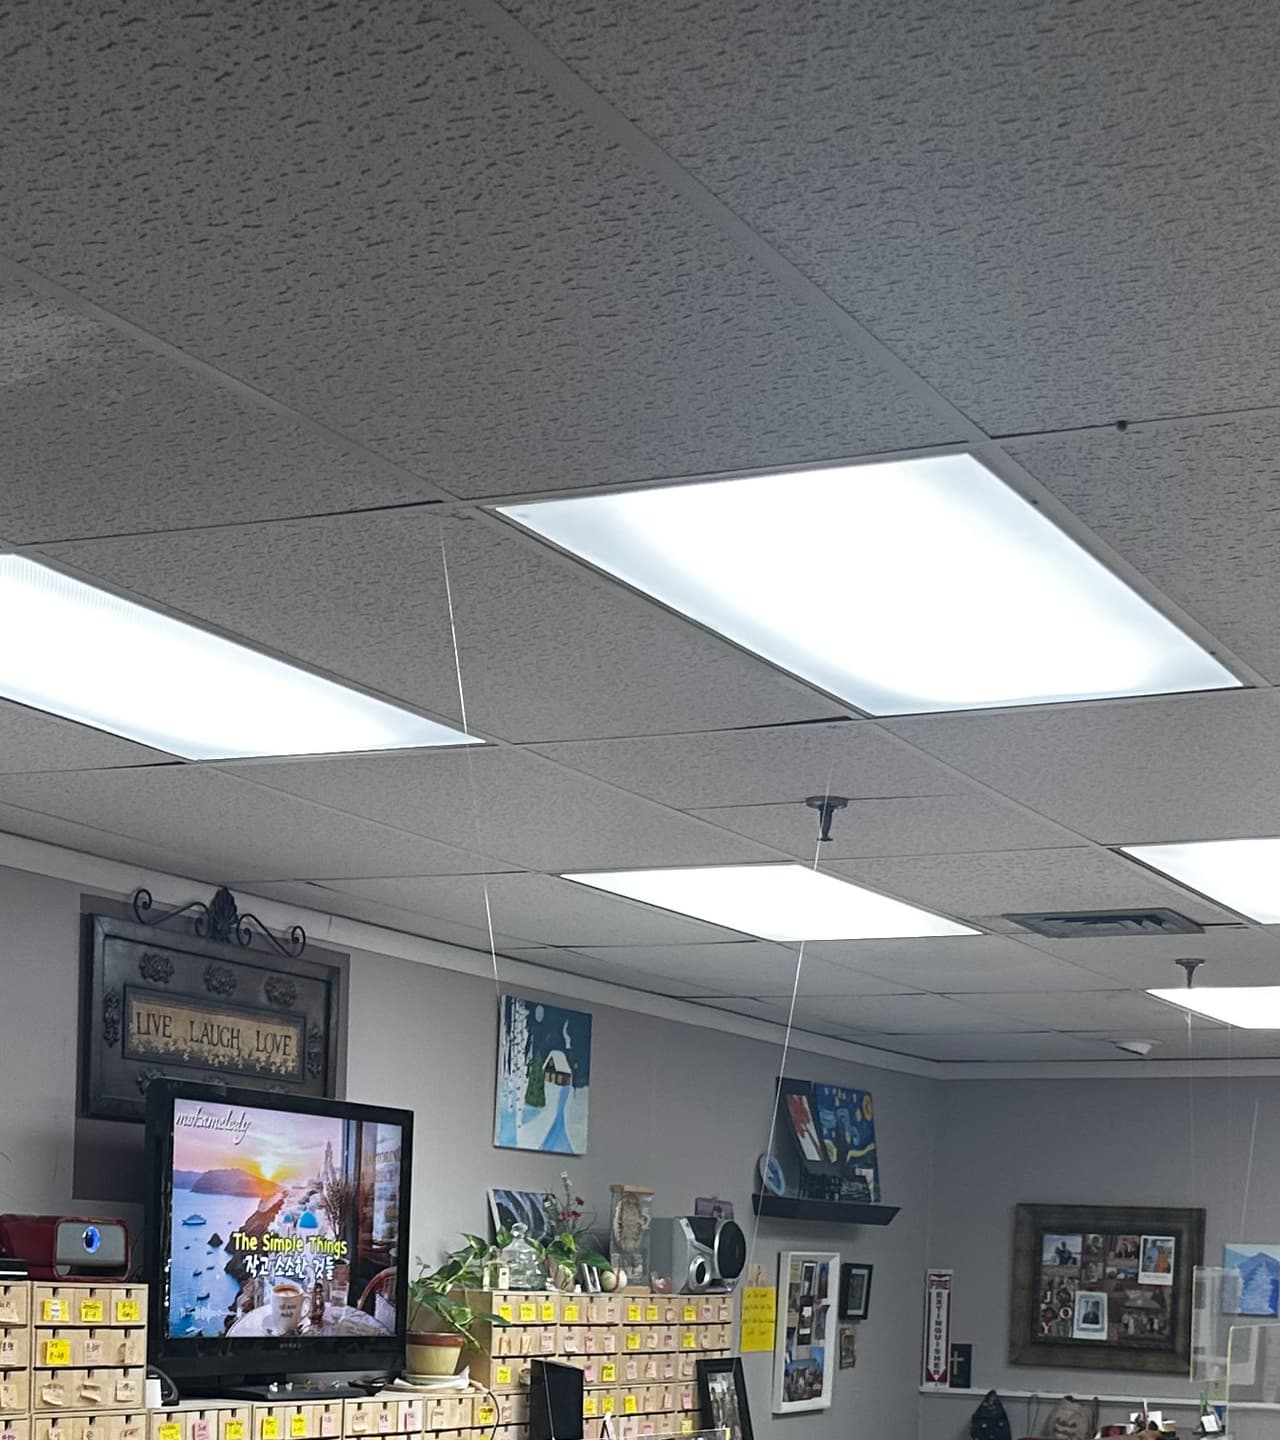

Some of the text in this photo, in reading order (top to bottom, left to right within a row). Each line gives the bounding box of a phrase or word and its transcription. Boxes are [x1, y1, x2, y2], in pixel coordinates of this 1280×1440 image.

[136, 1012, 292, 1056] LIVE LAUGH LOVE
[233, 1232, 348, 1260] The Simple Things
[244, 1254, 335, 1280] 작고 소소한 것들
[933, 1291, 943, 1374] EXTINGUISHER
